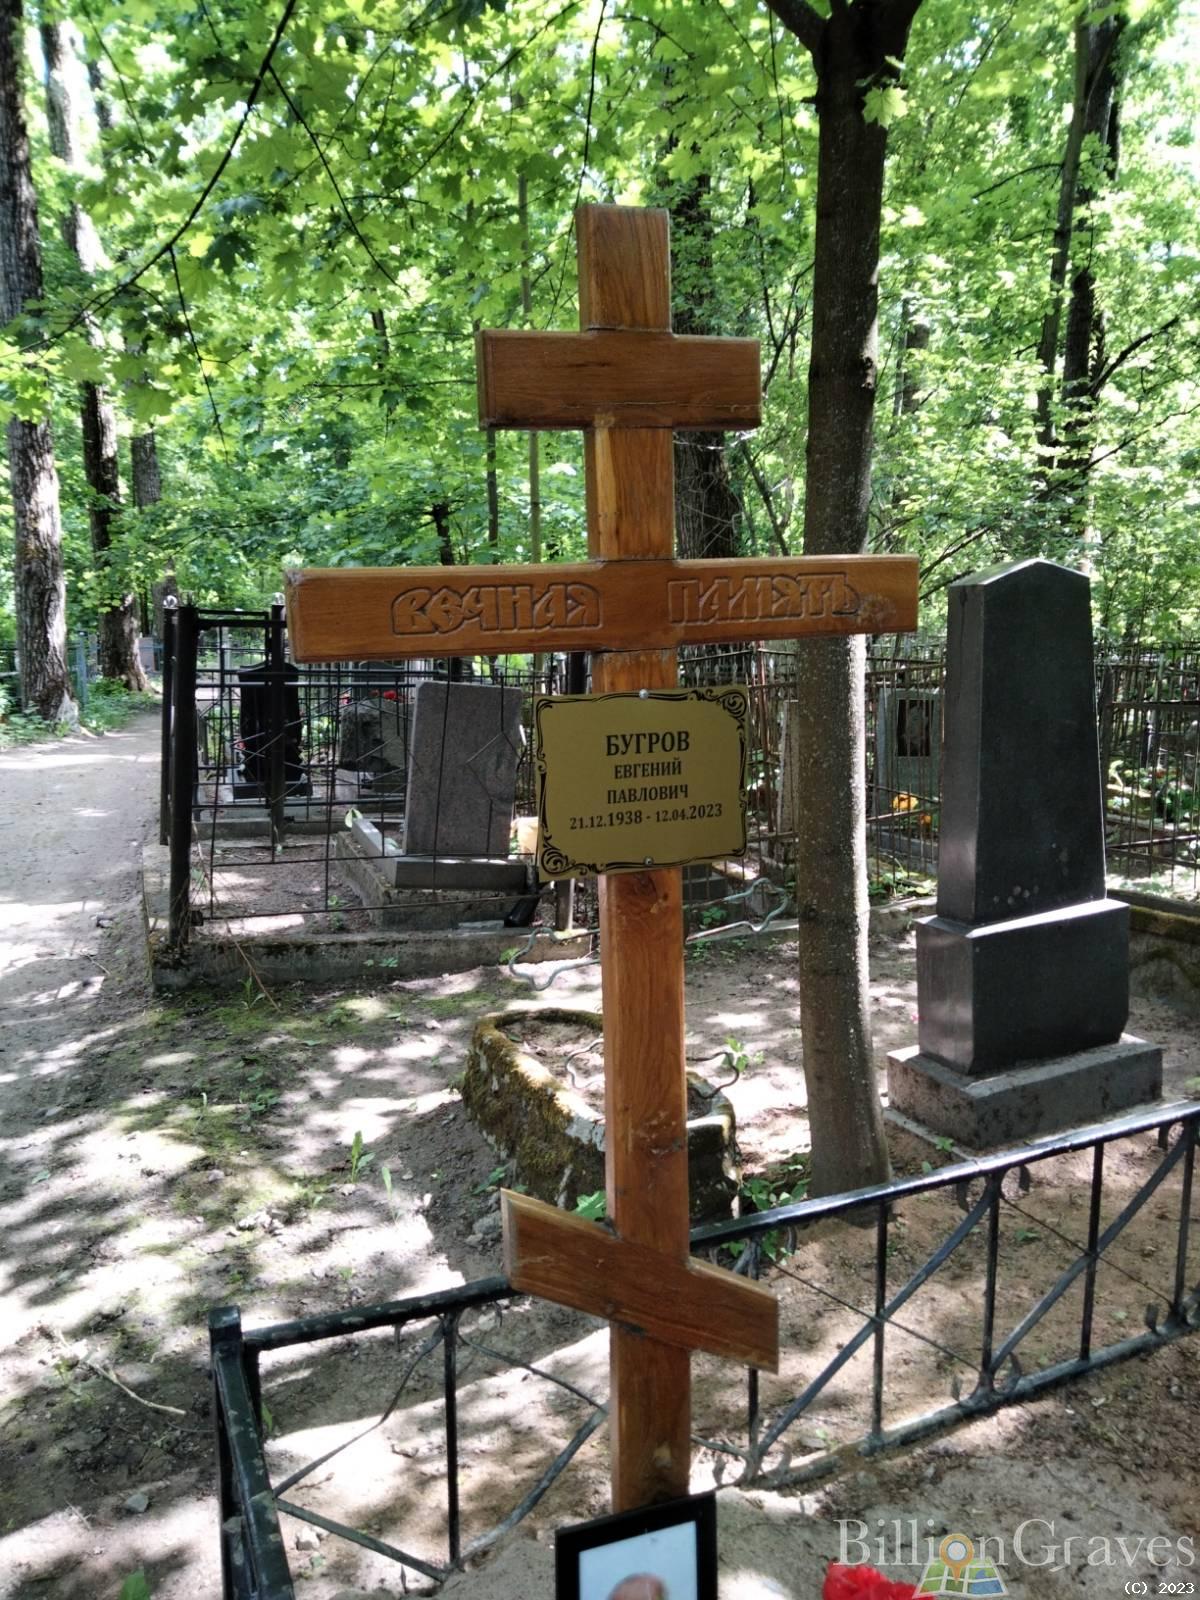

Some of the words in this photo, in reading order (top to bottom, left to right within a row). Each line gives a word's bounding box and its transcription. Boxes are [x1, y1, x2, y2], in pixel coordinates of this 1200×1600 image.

[392, 583, 602, 636] ВЕЧНАЯ
[668, 573, 861, 627] ПАМЯТЬ
[606, 731, 690, 756] БУГРОВ
[614, 757, 682, 780] ЕВГЕНИЙ
[607, 784, 689, 804] ПАВЛОВИЧ
[569, 810, 643, 830] 21.12.1938
[655, 803, 723, 823] 12.04.2023
